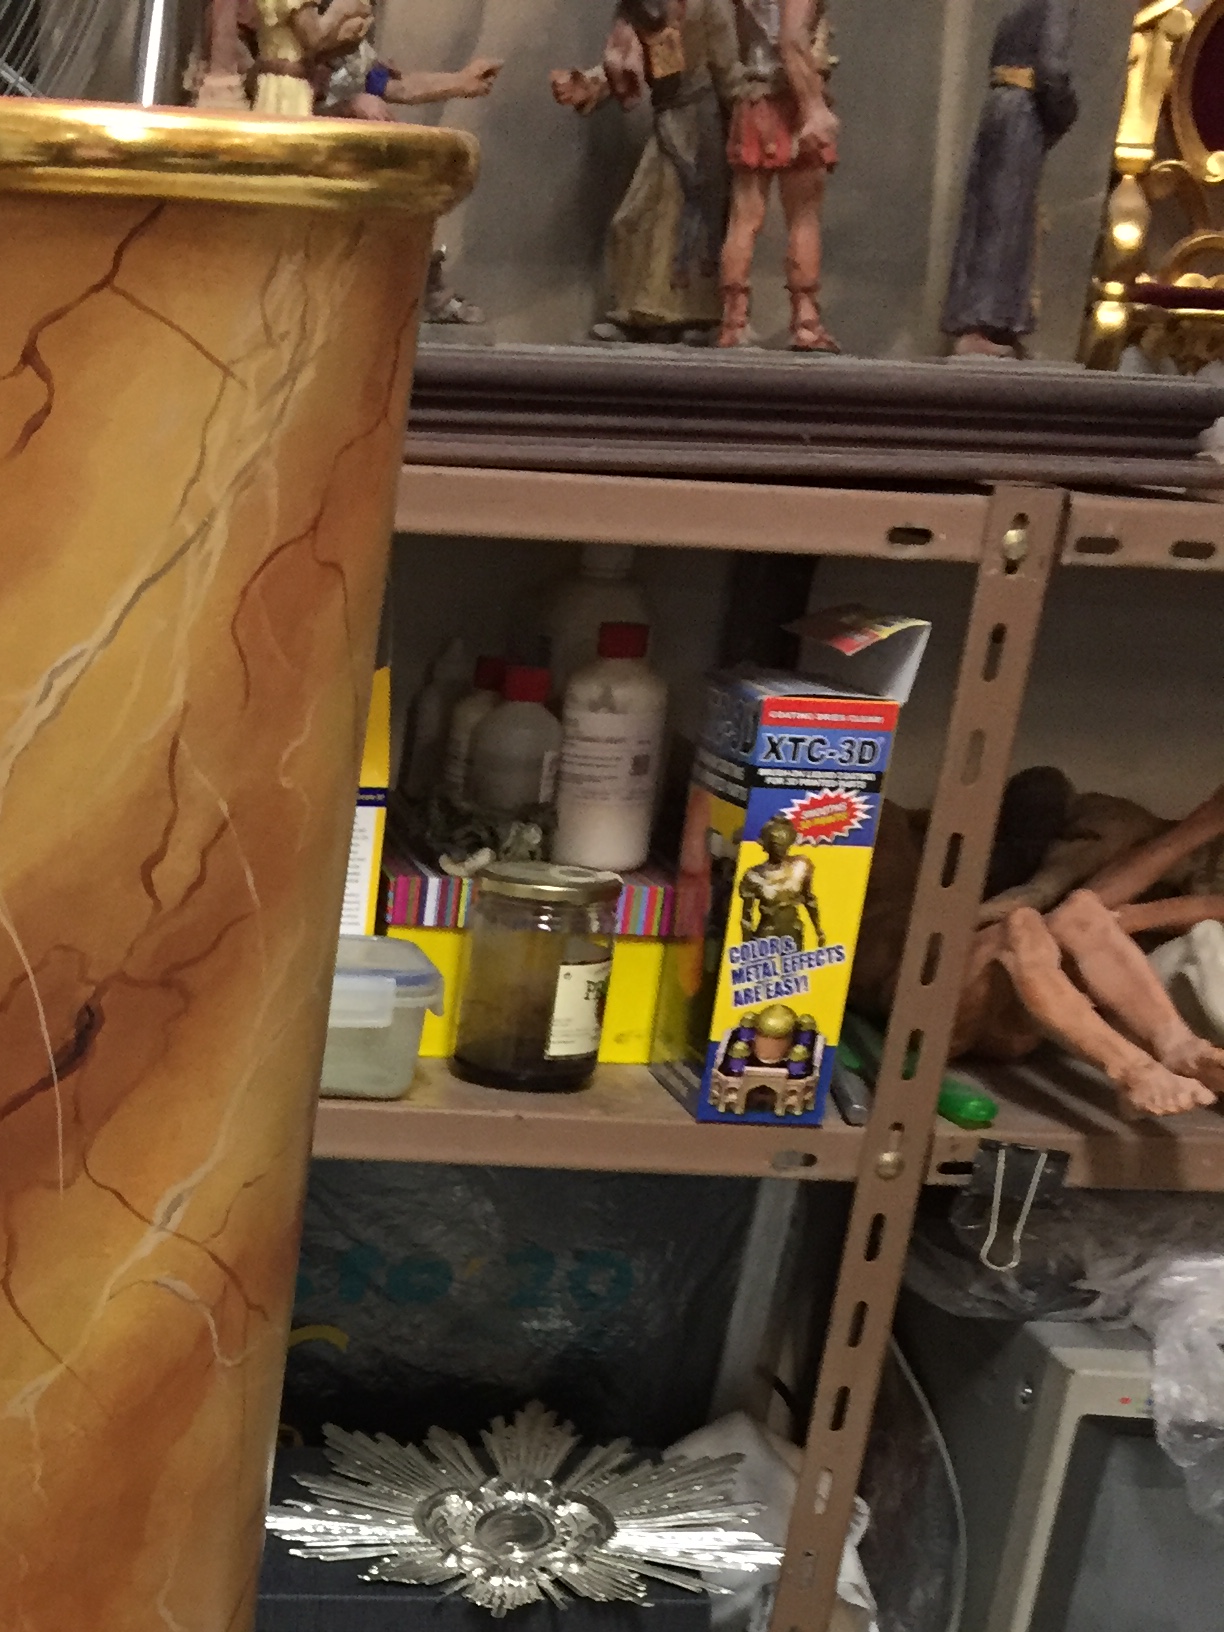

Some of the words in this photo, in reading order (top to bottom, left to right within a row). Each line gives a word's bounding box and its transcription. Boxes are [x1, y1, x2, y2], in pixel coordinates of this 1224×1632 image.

[759, 733, 881, 767] XTC-3D
[729, 936, 780, 964] COLOR
[731, 959, 781, 985] METAL
[781, 945, 846, 974] EFFECTS
[733, 985, 764, 1007] ARE
[766, 975, 810, 999] EASY!
